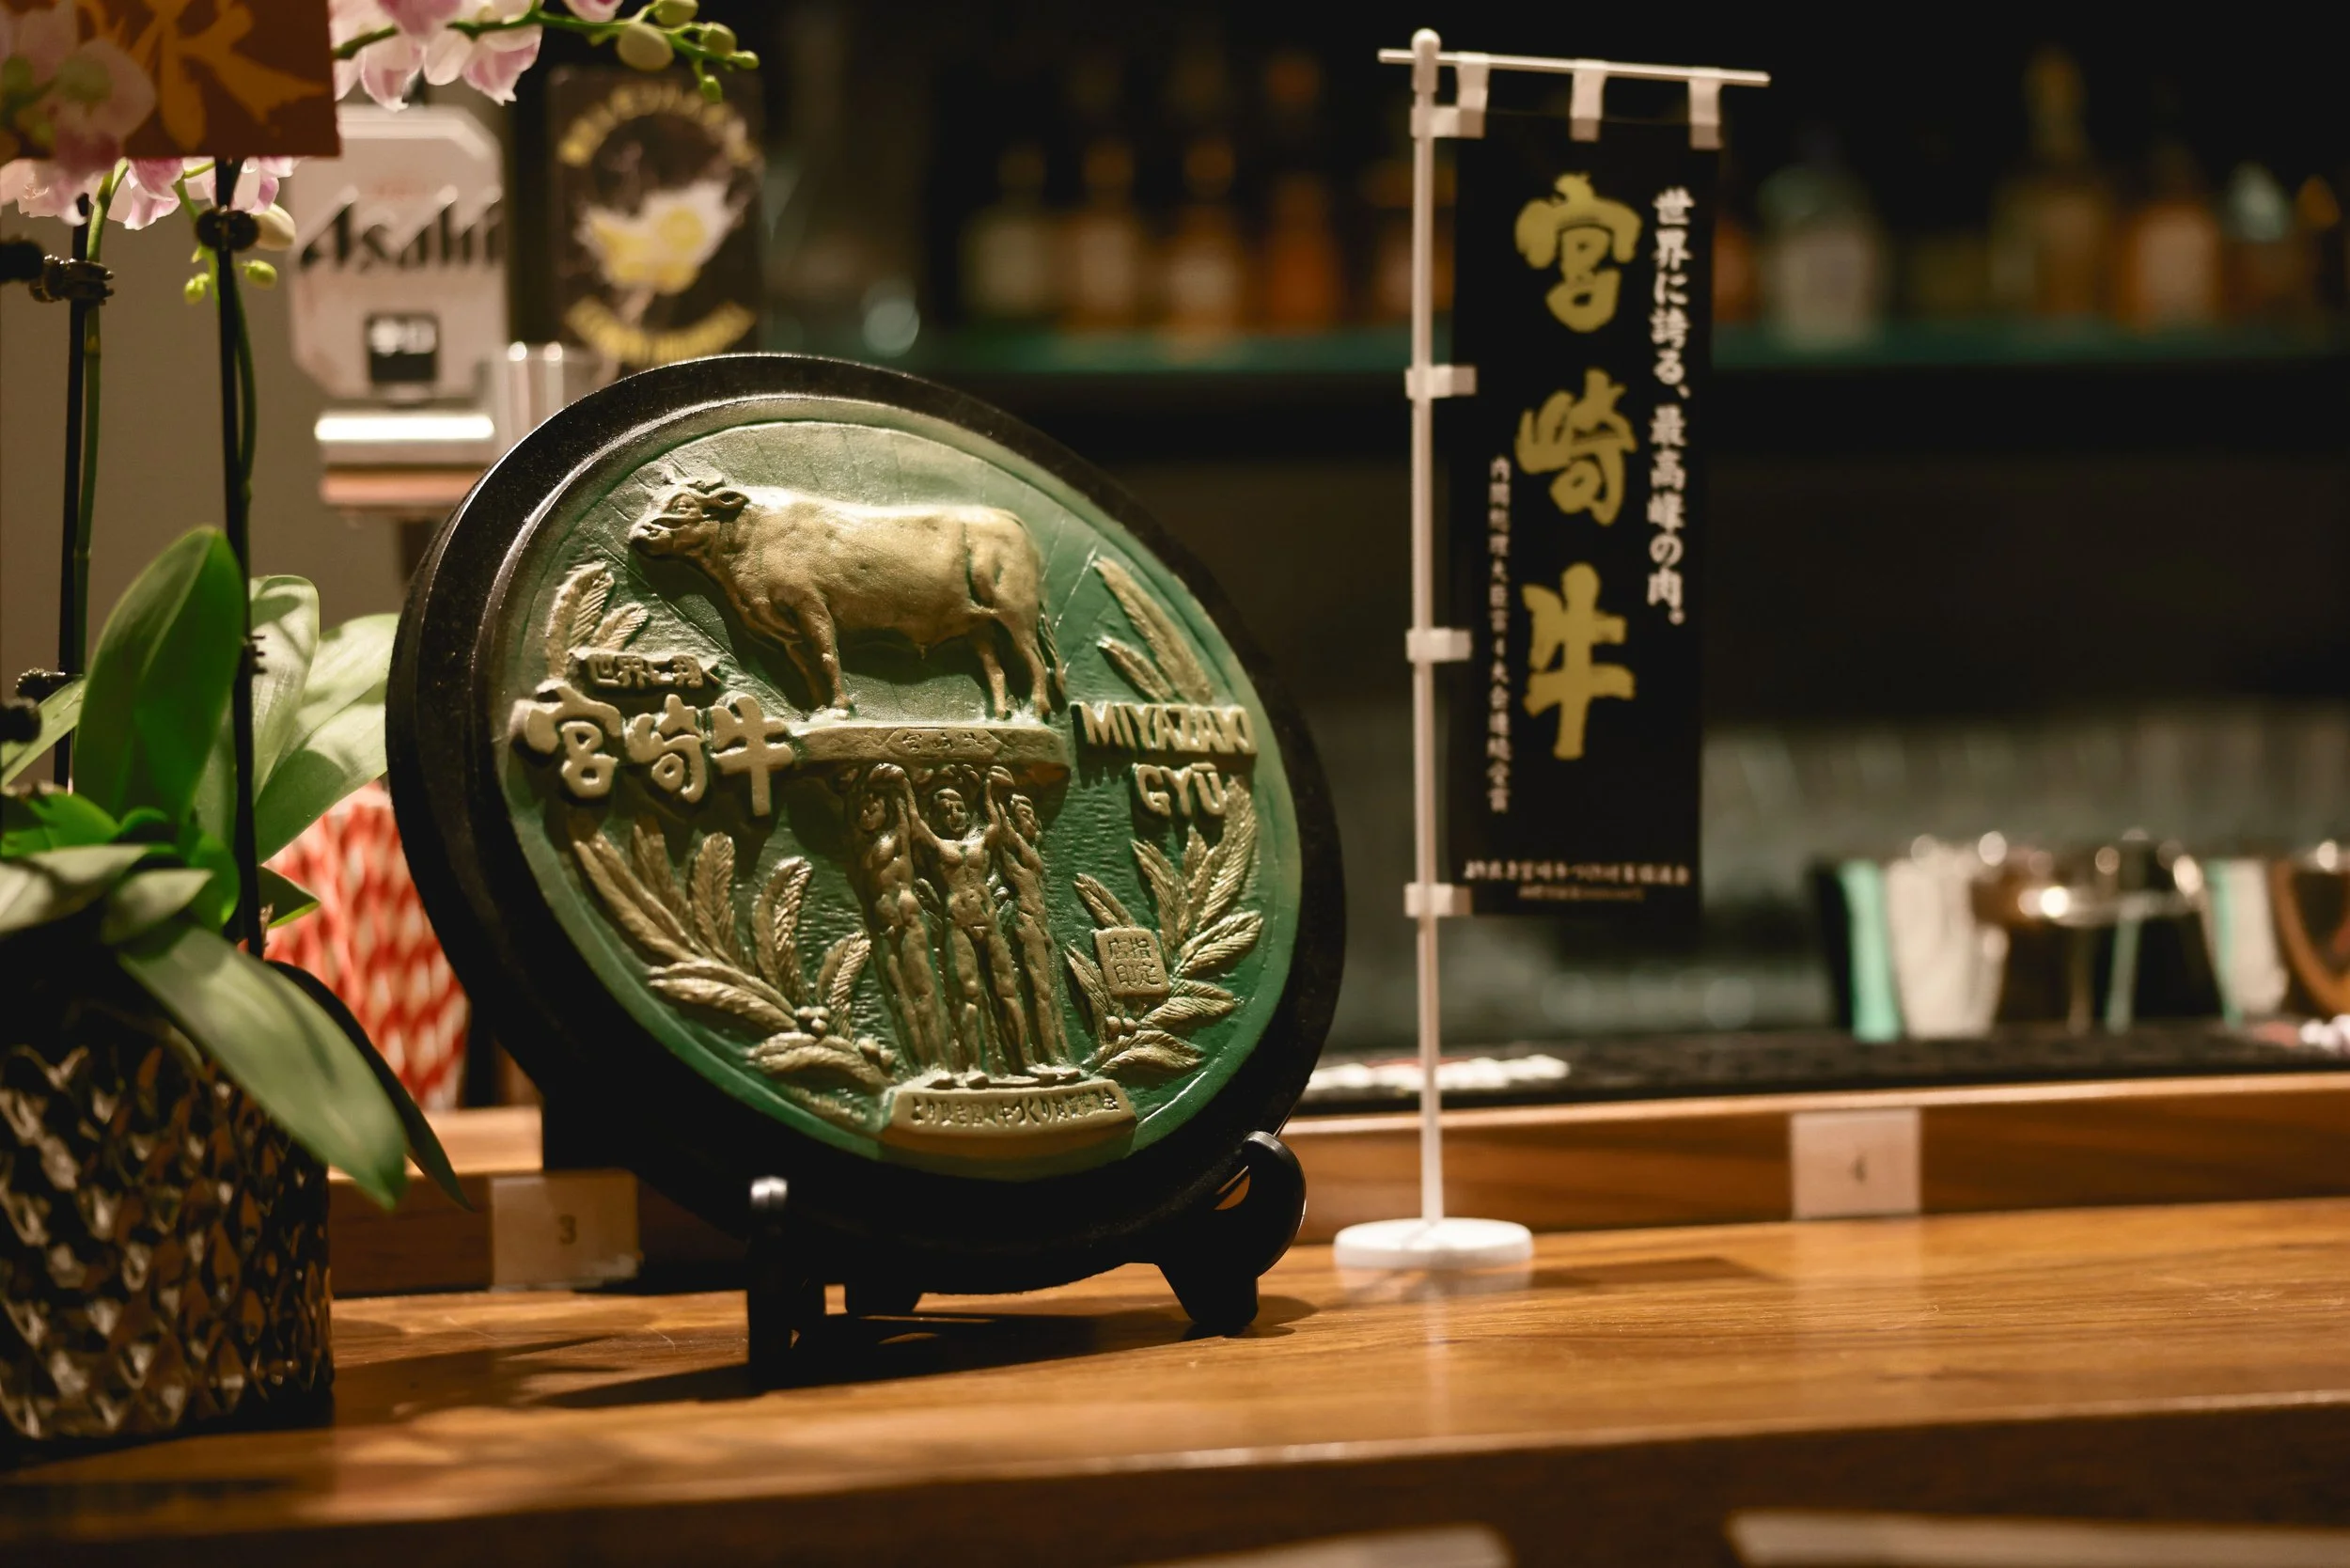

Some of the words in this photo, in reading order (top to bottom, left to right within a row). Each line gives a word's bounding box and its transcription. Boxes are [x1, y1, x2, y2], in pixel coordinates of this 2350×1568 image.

[1514, 171, 1644, 760] 宮崎牛
[512, 682, 794, 817] 宮崎牛
[1077, 701, 1257, 754] MIYAZAKI
[557, 1213, 577, 1247] 3
